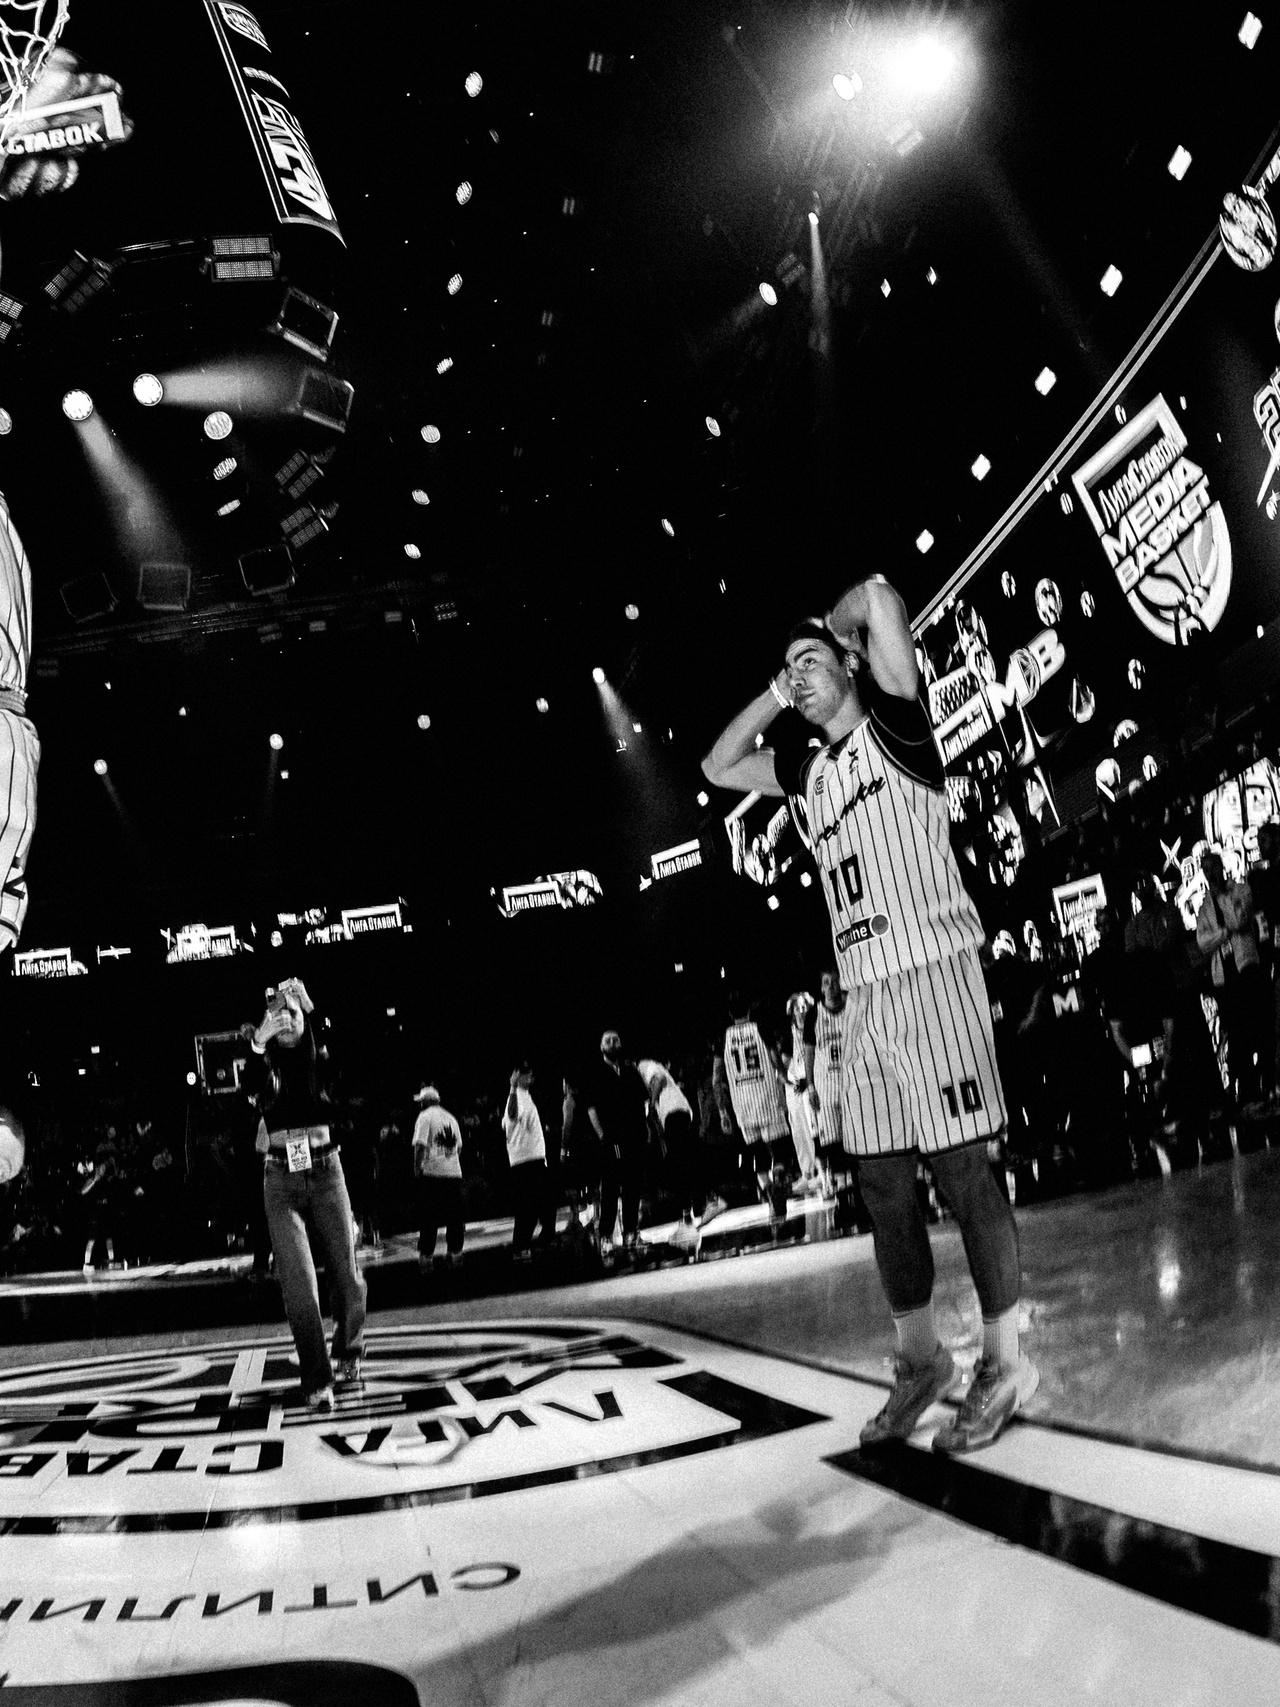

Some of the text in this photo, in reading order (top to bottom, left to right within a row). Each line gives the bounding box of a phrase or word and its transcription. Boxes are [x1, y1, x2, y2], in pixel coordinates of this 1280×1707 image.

[1101, 456, 1204, 569] MEDIA
[1115, 474, 1211, 594] BASKET
[828, 853, 864, 914] 10
[942, 1076, 983, 1118] 10
